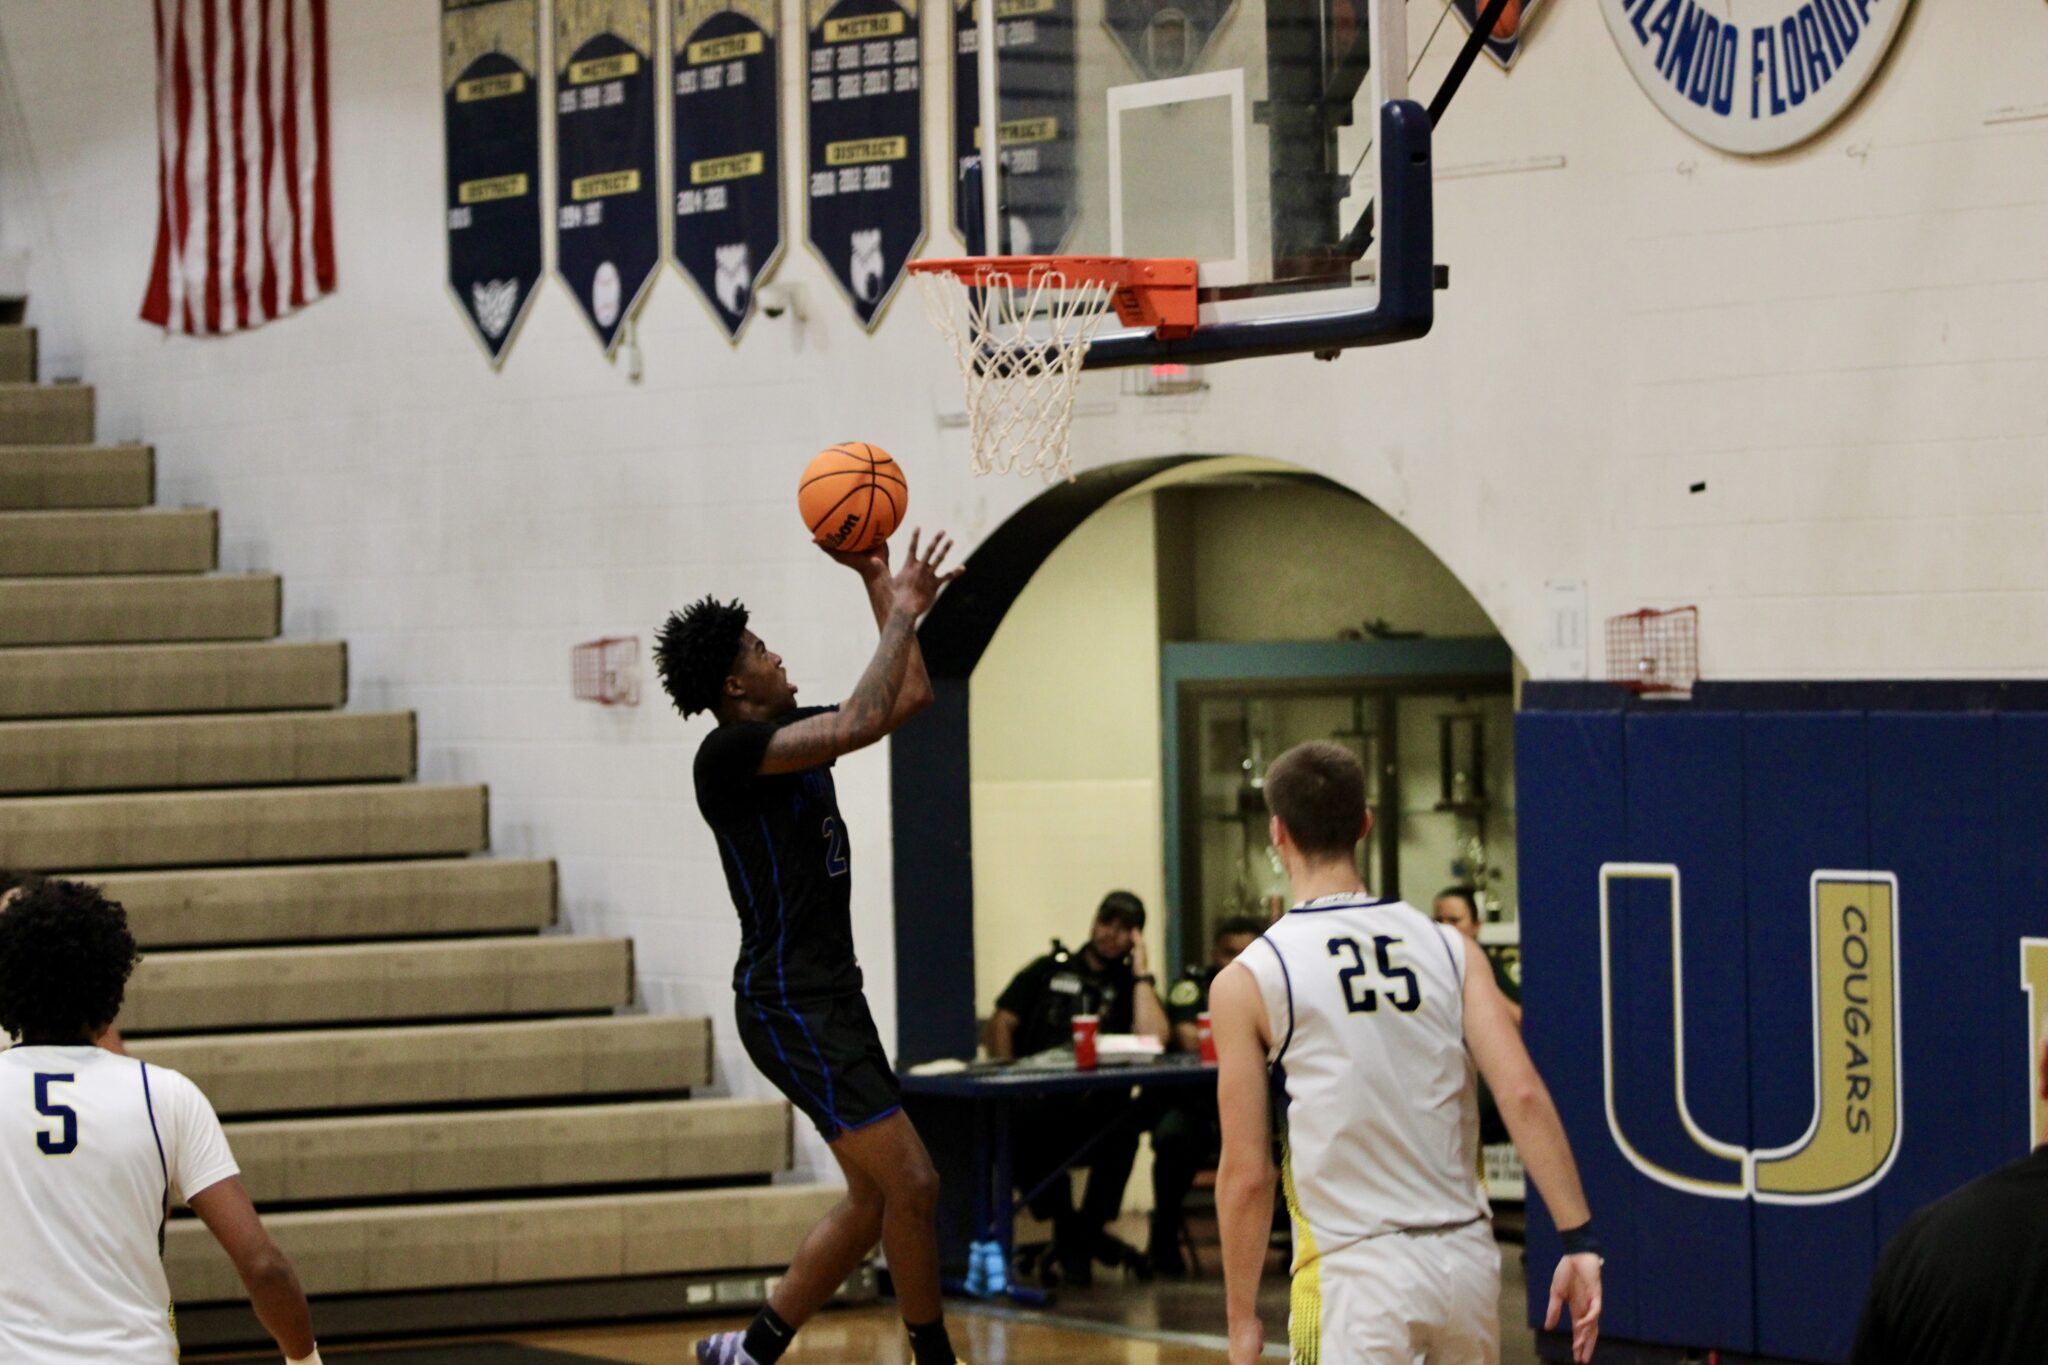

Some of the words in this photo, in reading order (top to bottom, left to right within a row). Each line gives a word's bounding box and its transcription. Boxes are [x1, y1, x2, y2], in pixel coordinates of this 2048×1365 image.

[700, 37, 747, 55] METRO
[837, 17, 889, 35] METRO
[1622, 0, 1738, 116] LANDO
[832, 141, 897, 160] DISTRICT
[821, 816, 849, 877] 2
[1327, 935, 1422, 1014] 25
[1842, 905, 1871, 1134] COUGARS
[33, 1072, 78, 1155] 5
